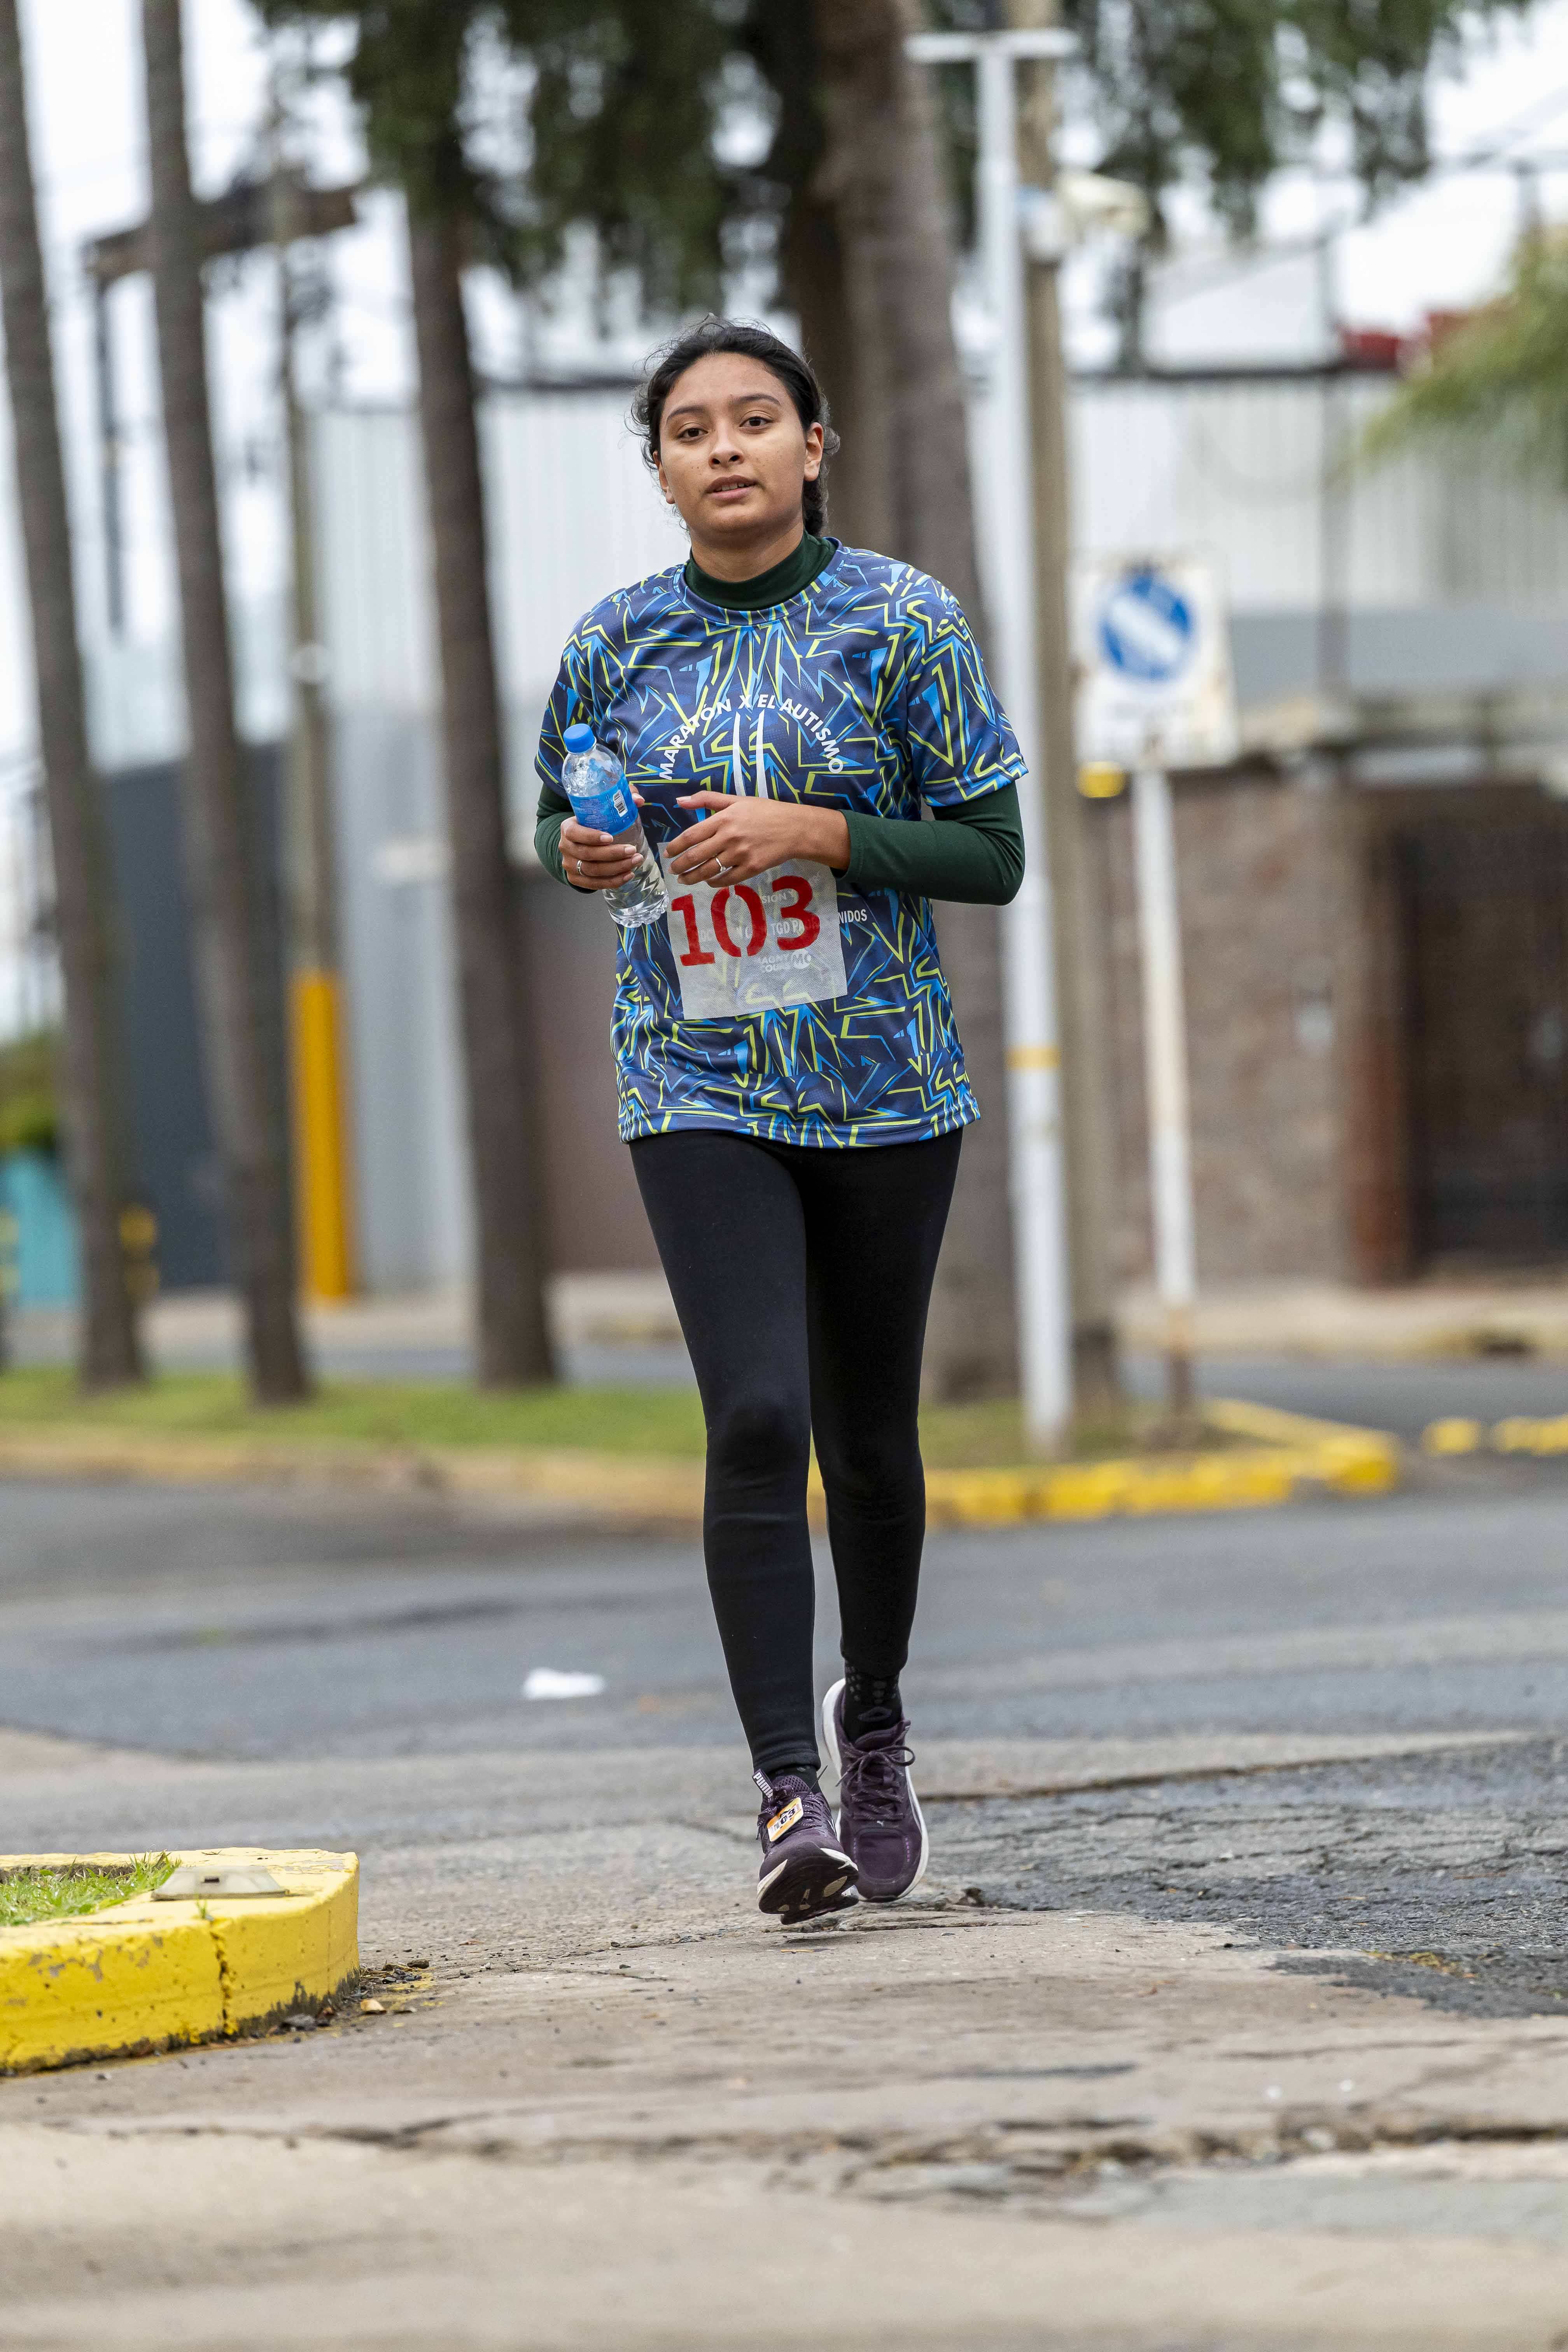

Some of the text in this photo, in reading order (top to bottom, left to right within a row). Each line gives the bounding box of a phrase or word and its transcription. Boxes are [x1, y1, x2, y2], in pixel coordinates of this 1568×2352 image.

[659, 694, 844, 780] MARATÓN X EL AUTISMO
[672, 875, 821, 966] 103
[838, 909, 867, 924] NIDOS
[753, 1772, 773, 1798] PUMA
